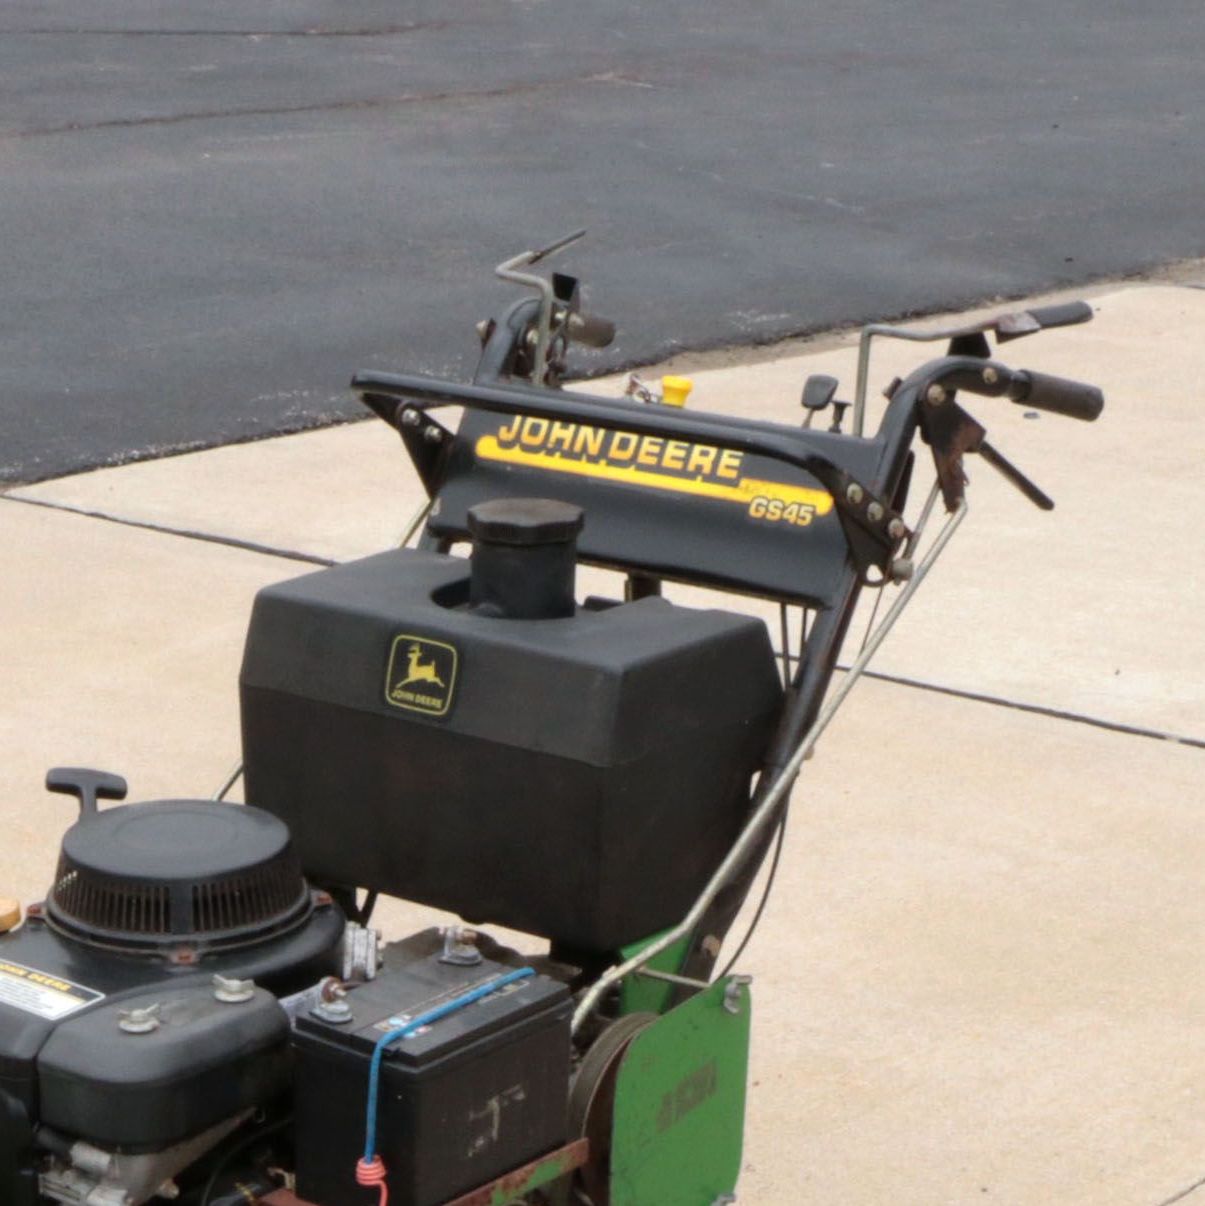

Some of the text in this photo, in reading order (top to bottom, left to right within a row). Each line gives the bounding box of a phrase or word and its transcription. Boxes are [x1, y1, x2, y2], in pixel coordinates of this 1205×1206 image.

[497, 415, 745, 479] JOHN DEERE
[747, 496, 818, 528] GS45
[415, 695, 442, 708] DEERE
[27, 973, 71, 991] DEERE
